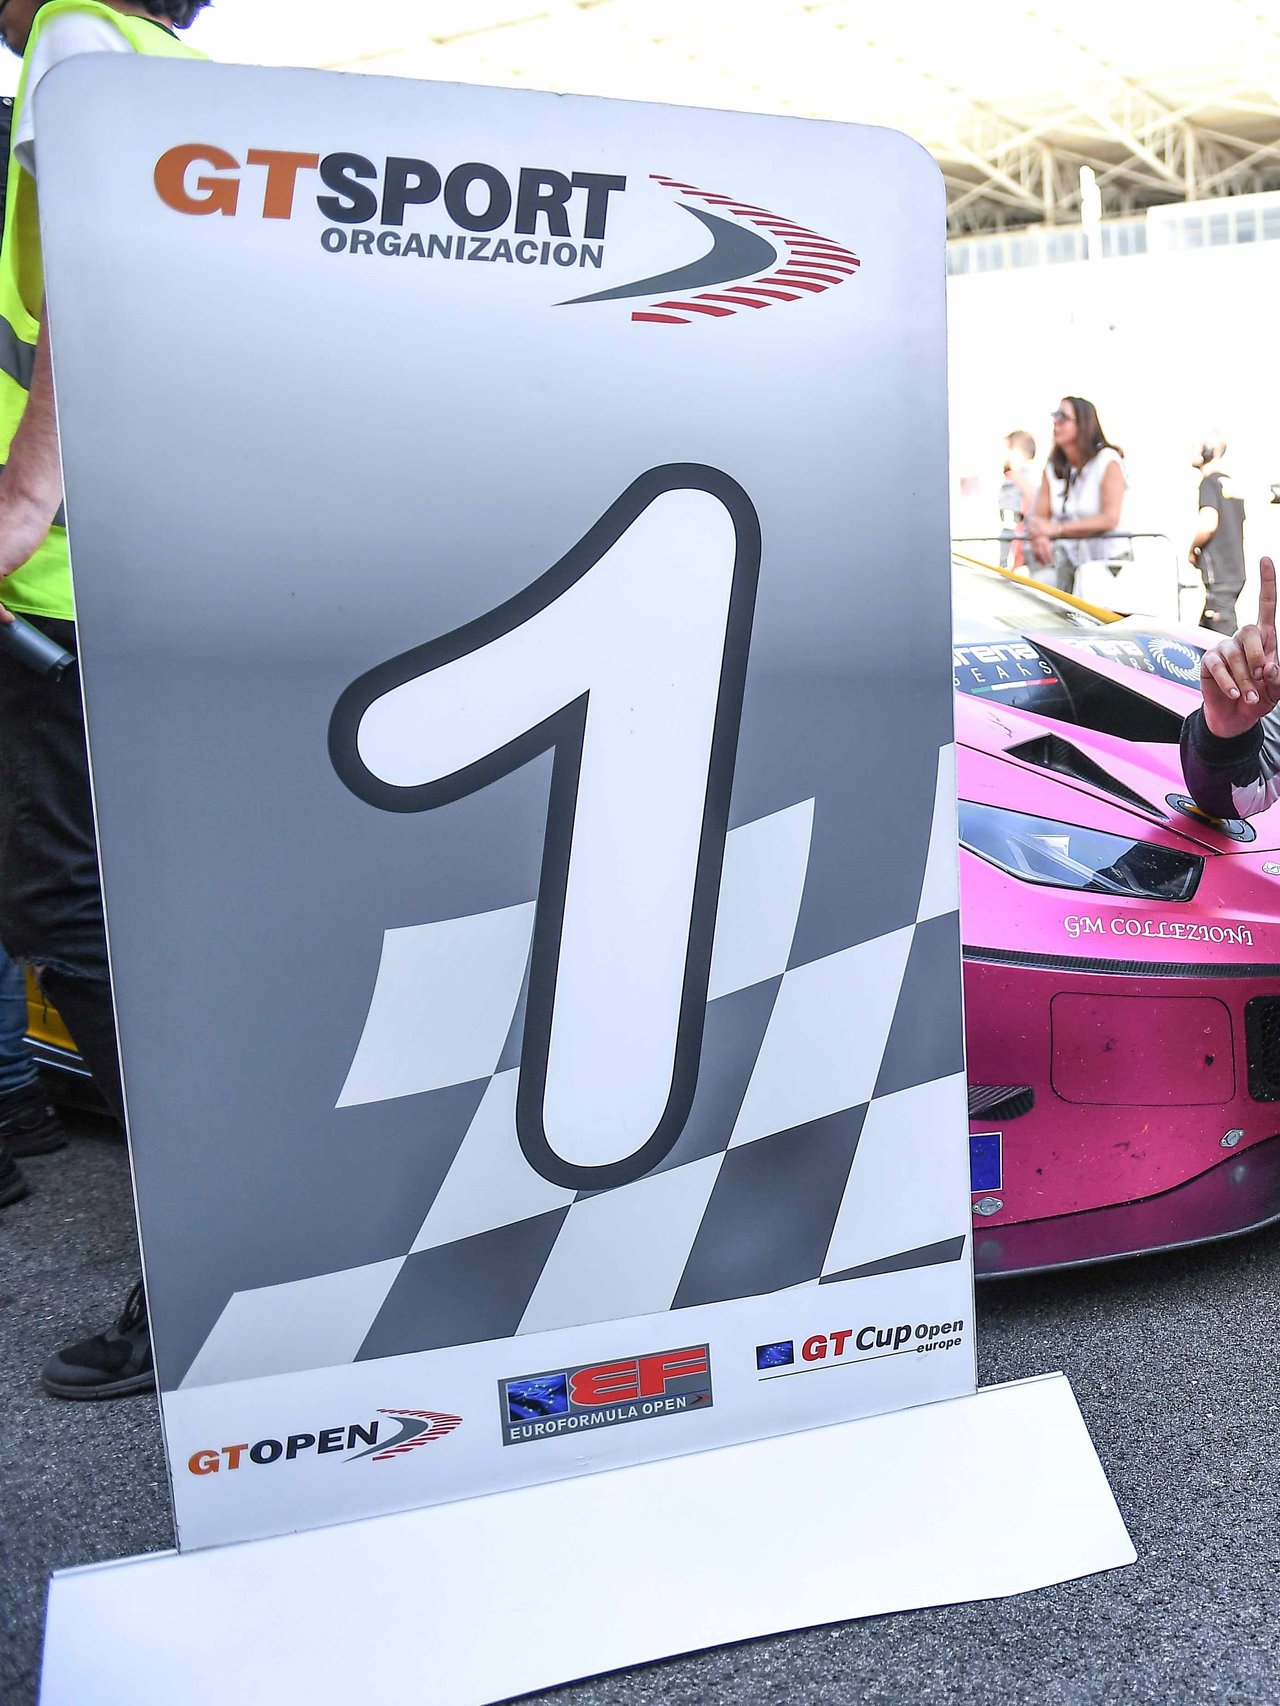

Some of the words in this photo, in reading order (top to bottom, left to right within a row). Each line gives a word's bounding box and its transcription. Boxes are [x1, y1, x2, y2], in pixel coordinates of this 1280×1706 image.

[153, 143, 627, 239] GTSPORT
[320, 227, 605, 269] ORGANIZACION
[328, 463, 762, 1190] 1
[1064, 915, 1106, 938] GM
[1110, 918, 1254, 946] COLLEZIONI
[802, 1329, 853, 1362] GT
[856, 1324, 912, 1351] Cup
[915, 1319, 964, 1340] Open
[916, 1336, 962, 1353] europe
[510, 1406, 638, 1440] EUROFORMULA
[643, 1396, 687, 1416] OPEN
[188, 1420, 380, 1475] GTOPEN
